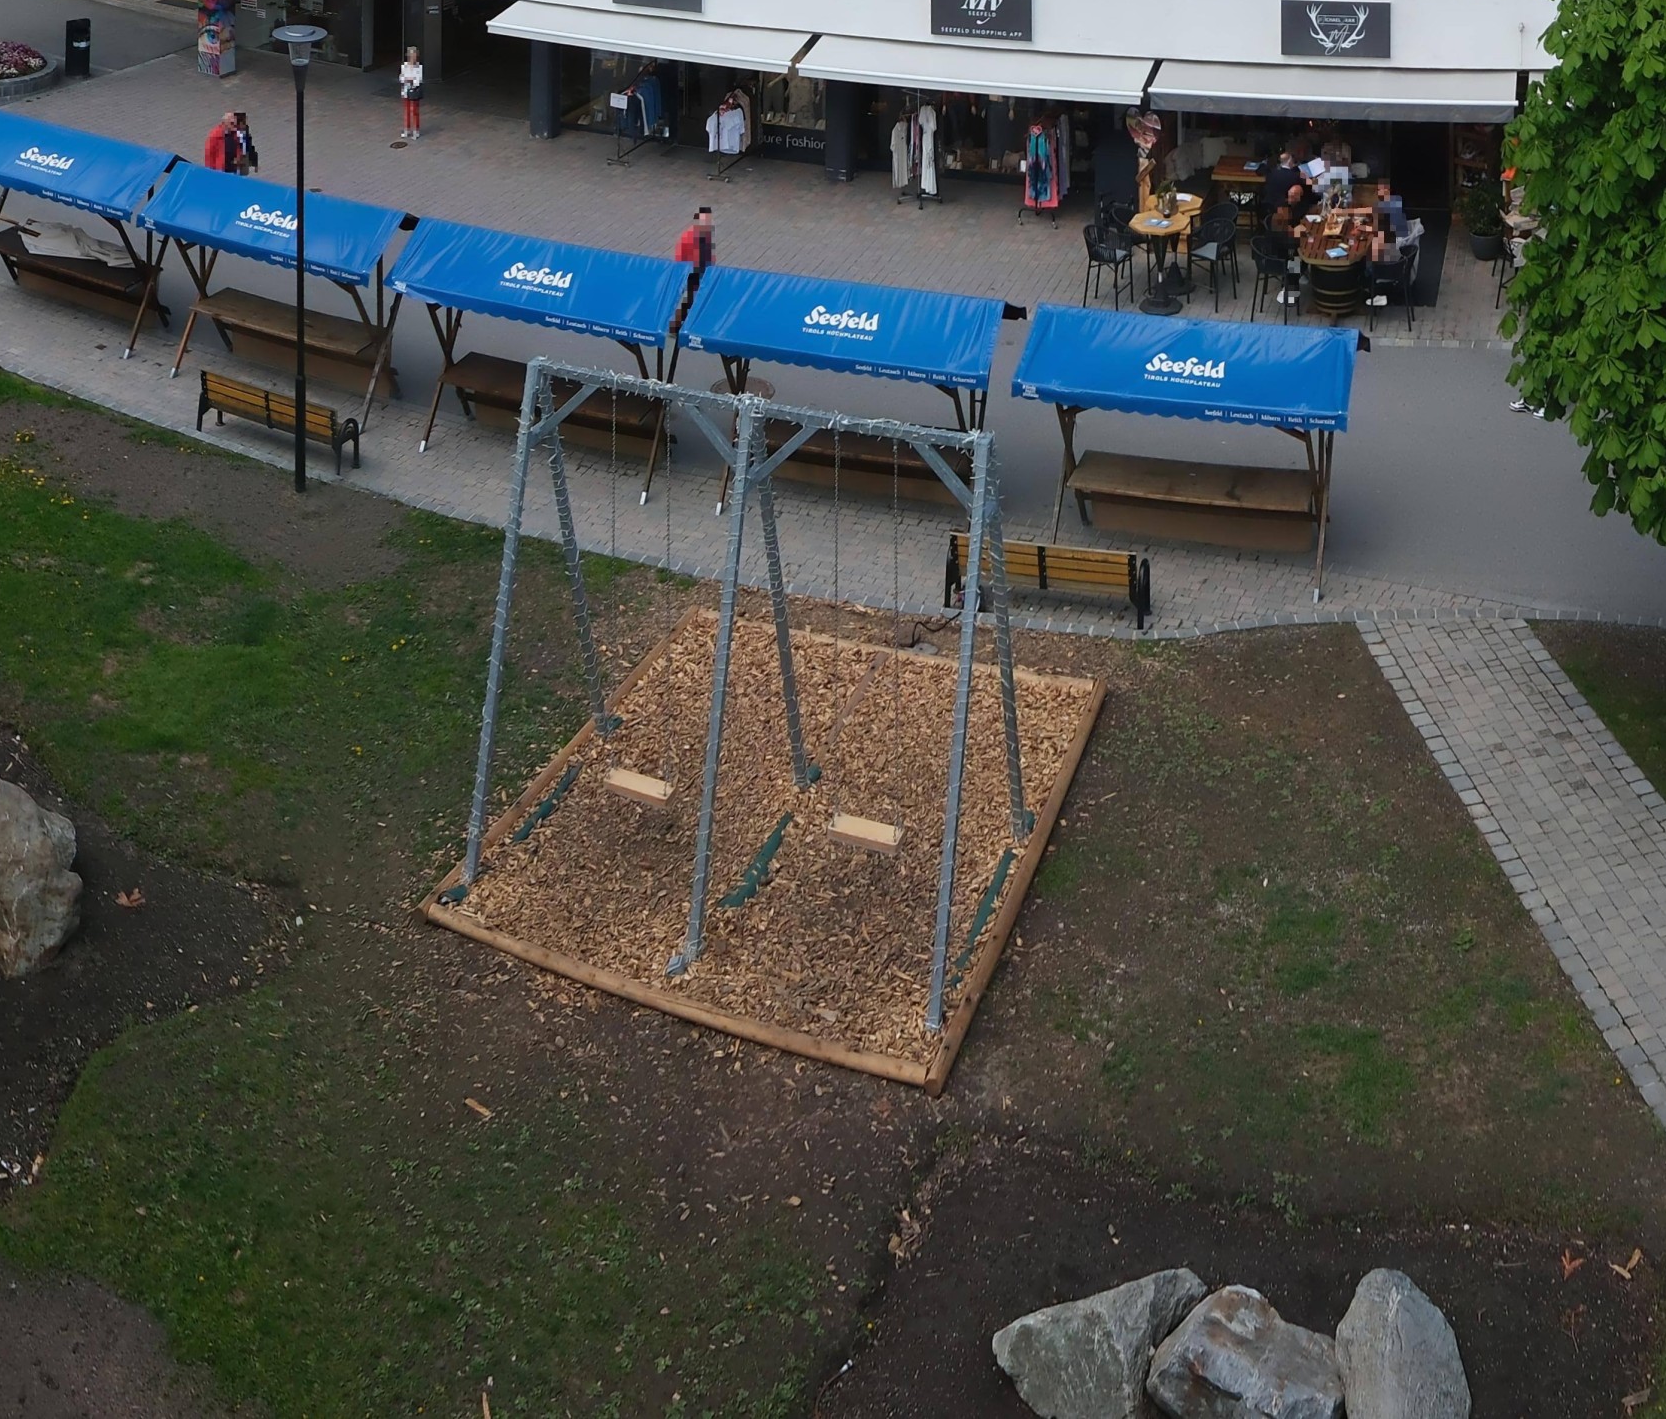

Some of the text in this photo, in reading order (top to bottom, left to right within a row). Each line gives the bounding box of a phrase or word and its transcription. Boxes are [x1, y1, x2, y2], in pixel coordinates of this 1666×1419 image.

[968, 10, 996, 18] SEEFELD
[941, 26, 970, 34] SEEFELD
[972, 28, 1007, 37] SHOPPING
[19, 146, 75, 171] Seefeld
[239, 203, 298, 232] Seefeld
[502, 261, 573, 290] Seefeld
[803, 305, 879, 332] Seefeld
[802, 326, 874, 342] TIROLS HOCHPLATEAU
[1144, 352, 1225, 380] Seefeld
[1143, 373, 1221, 388] TIROLS HOCHPLATEAU
